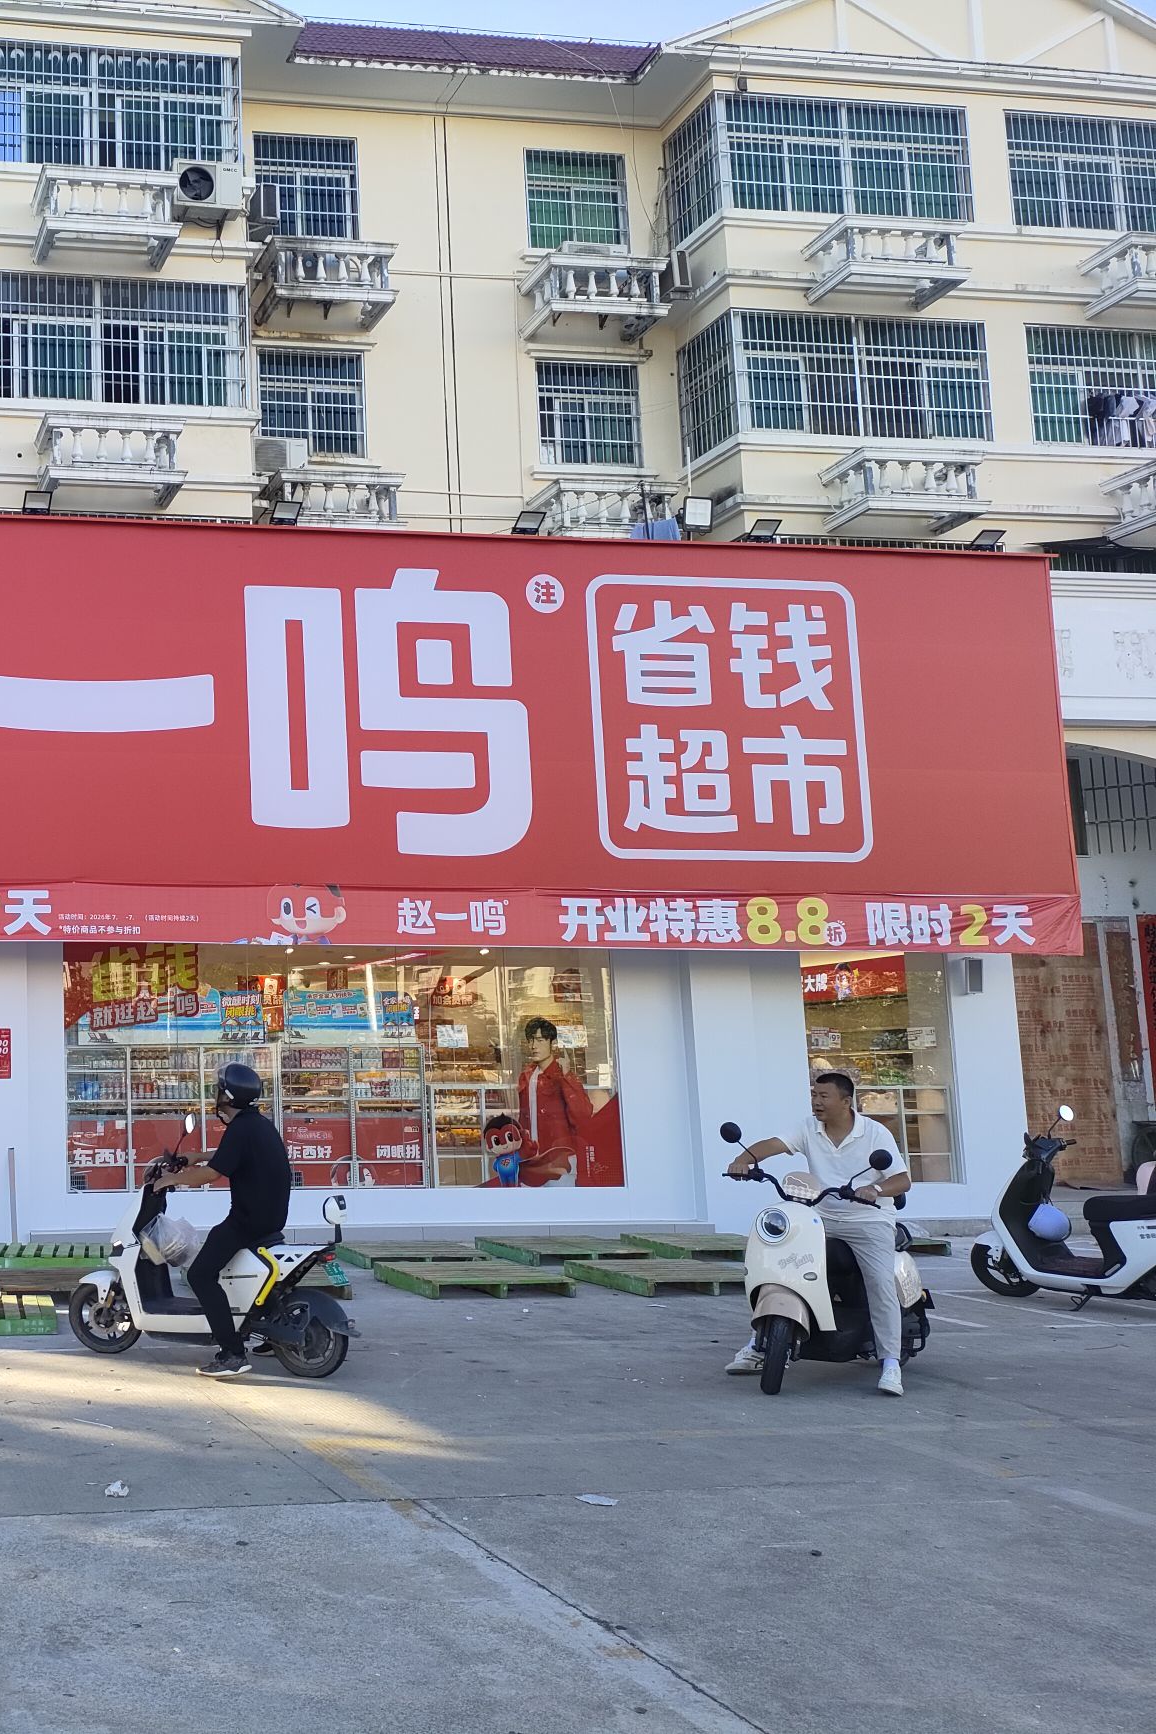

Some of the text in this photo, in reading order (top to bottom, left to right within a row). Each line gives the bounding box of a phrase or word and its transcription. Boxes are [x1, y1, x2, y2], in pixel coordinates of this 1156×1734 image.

[534, 580, 557, 604] 注
[612, 599, 834, 711] 省钱
[623, 724, 848, 836] 超市
[396, 897, 507, 935] 赵一鸣
[865, 901, 1036, 946] 限时2天
[801, 973, 828, 992] 大牌
[92, 994, 196, 1028] 就逛赵一鸣
[73, 1148, 137, 1166] 东西好
[286, 1145, 332, 1159] 东西好
[376, 1144, 421, 1158] 闭眼挑
